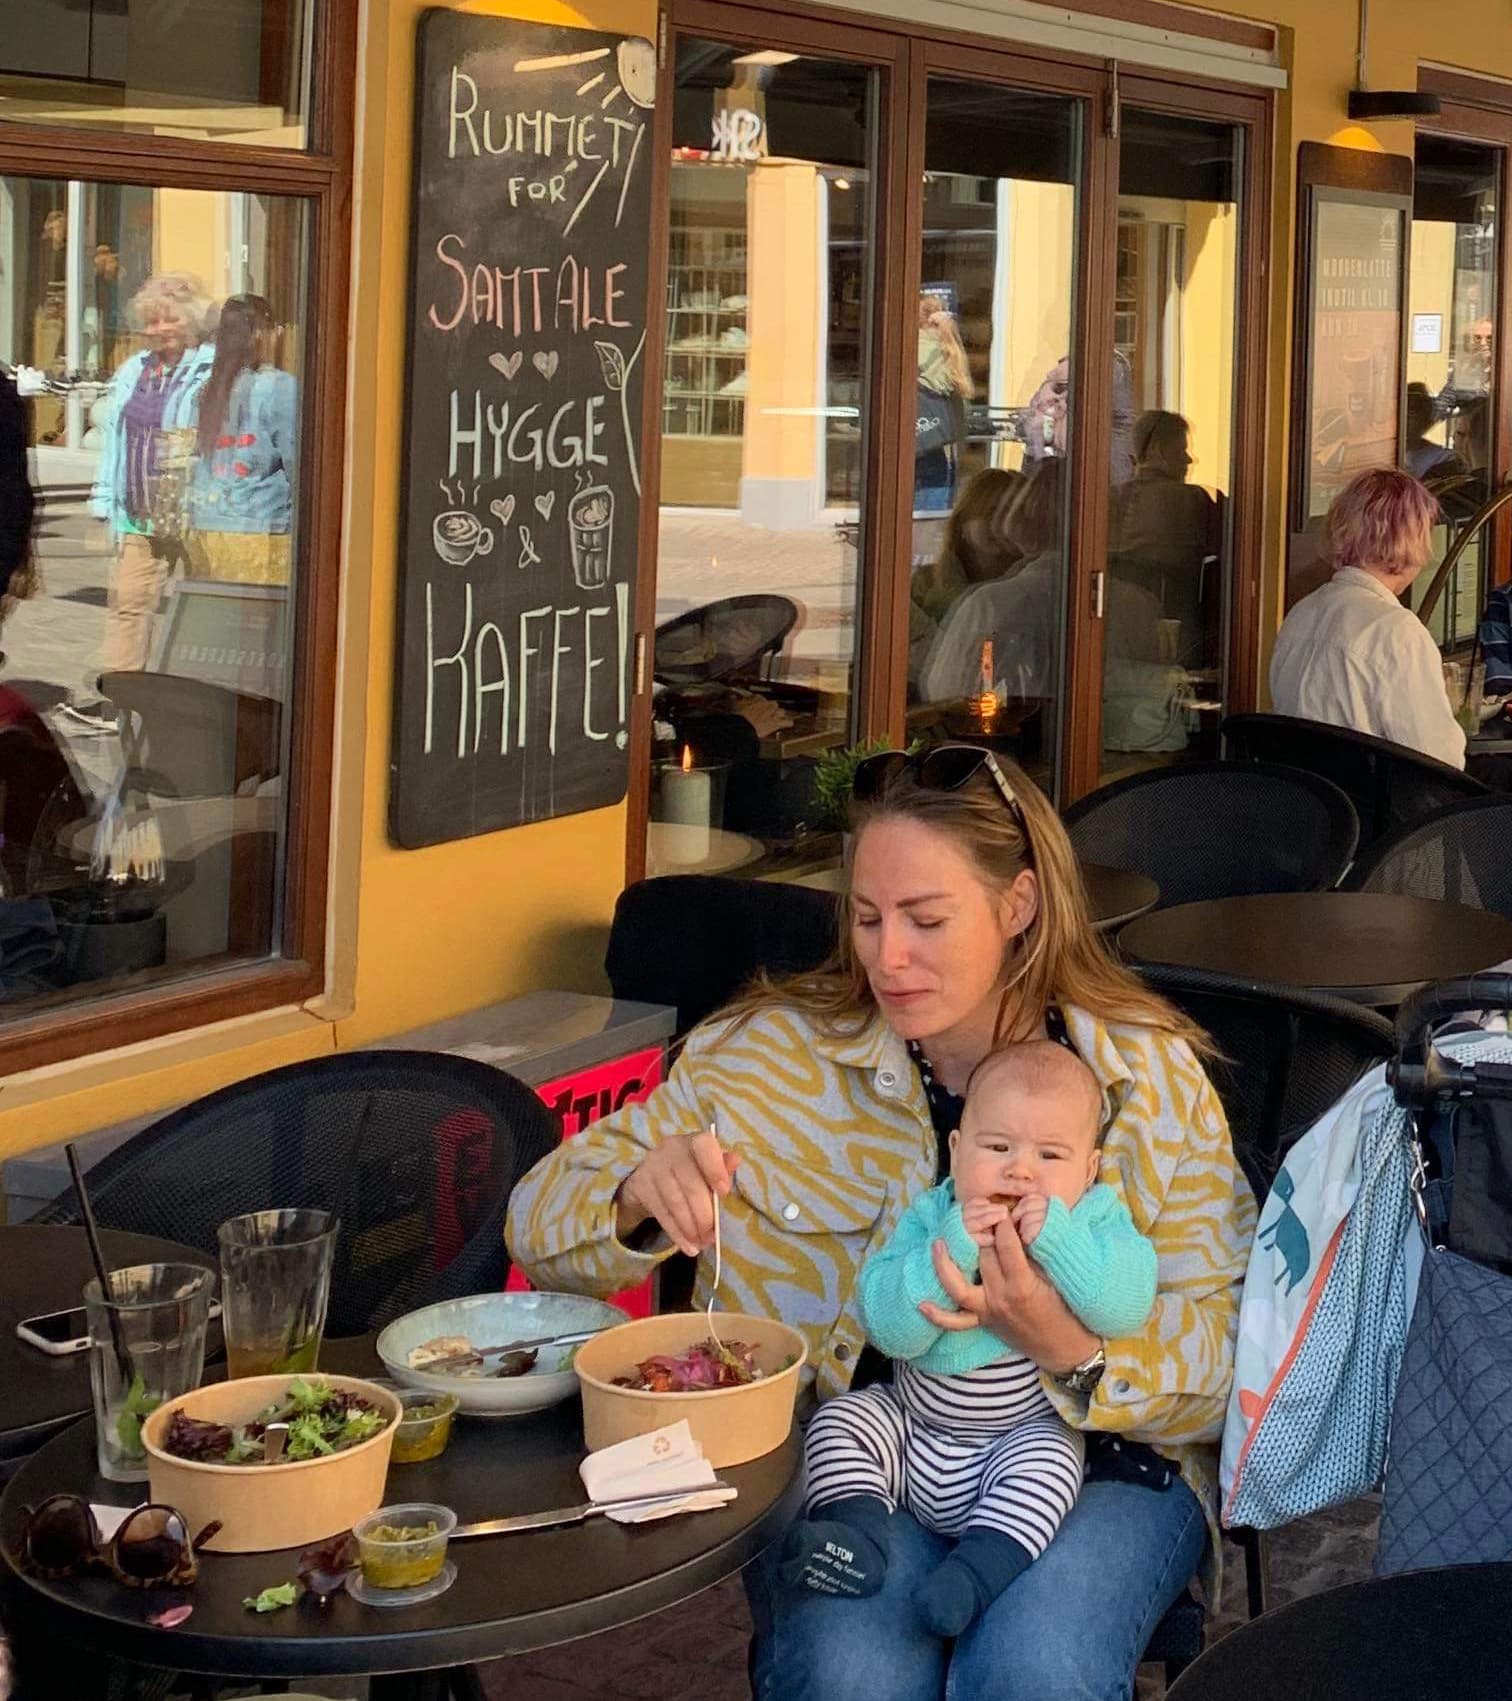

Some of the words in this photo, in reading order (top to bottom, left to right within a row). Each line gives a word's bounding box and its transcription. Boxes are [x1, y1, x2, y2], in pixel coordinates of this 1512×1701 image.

[448, 66, 636, 168] RUMMET
[508, 175, 567, 207] FOR
[449, 389, 609, 480] HYGGE
[518, 525, 541, 569] &
[424, 582, 630, 758] KAFFE!
